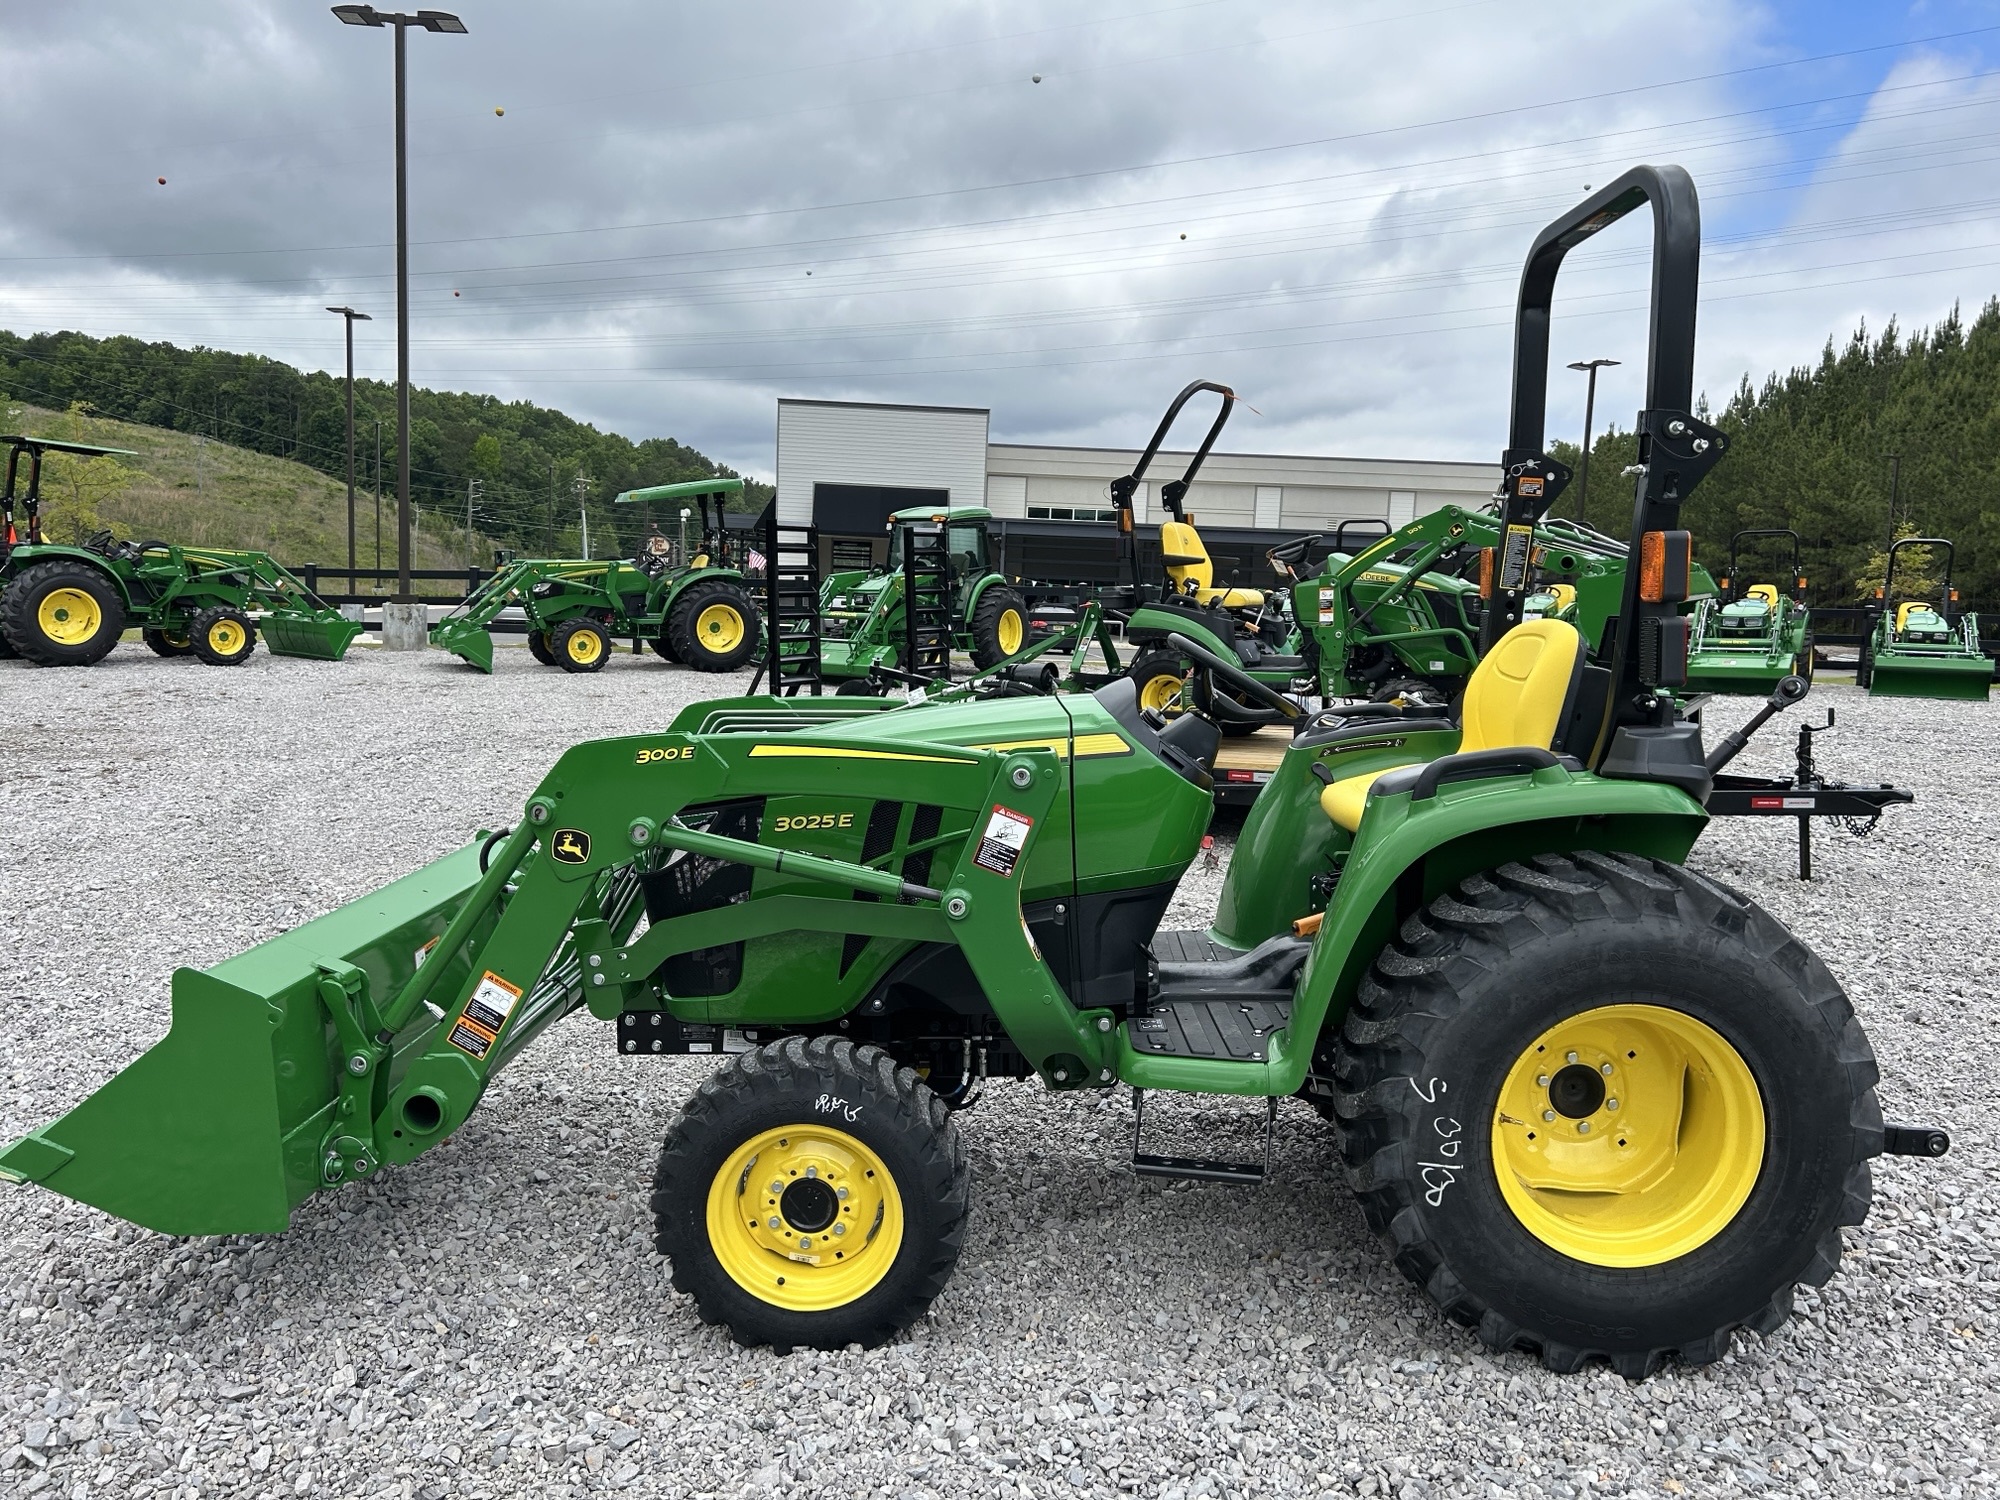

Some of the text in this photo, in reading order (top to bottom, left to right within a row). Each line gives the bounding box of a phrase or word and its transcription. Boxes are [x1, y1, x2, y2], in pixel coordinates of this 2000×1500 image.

[1365, 573, 1391, 582] DEERE
[1005, 810, 1030, 825] DANGER
[494, 977, 519, 995] WARNING
[468, 1023, 492, 1041] WARNING
